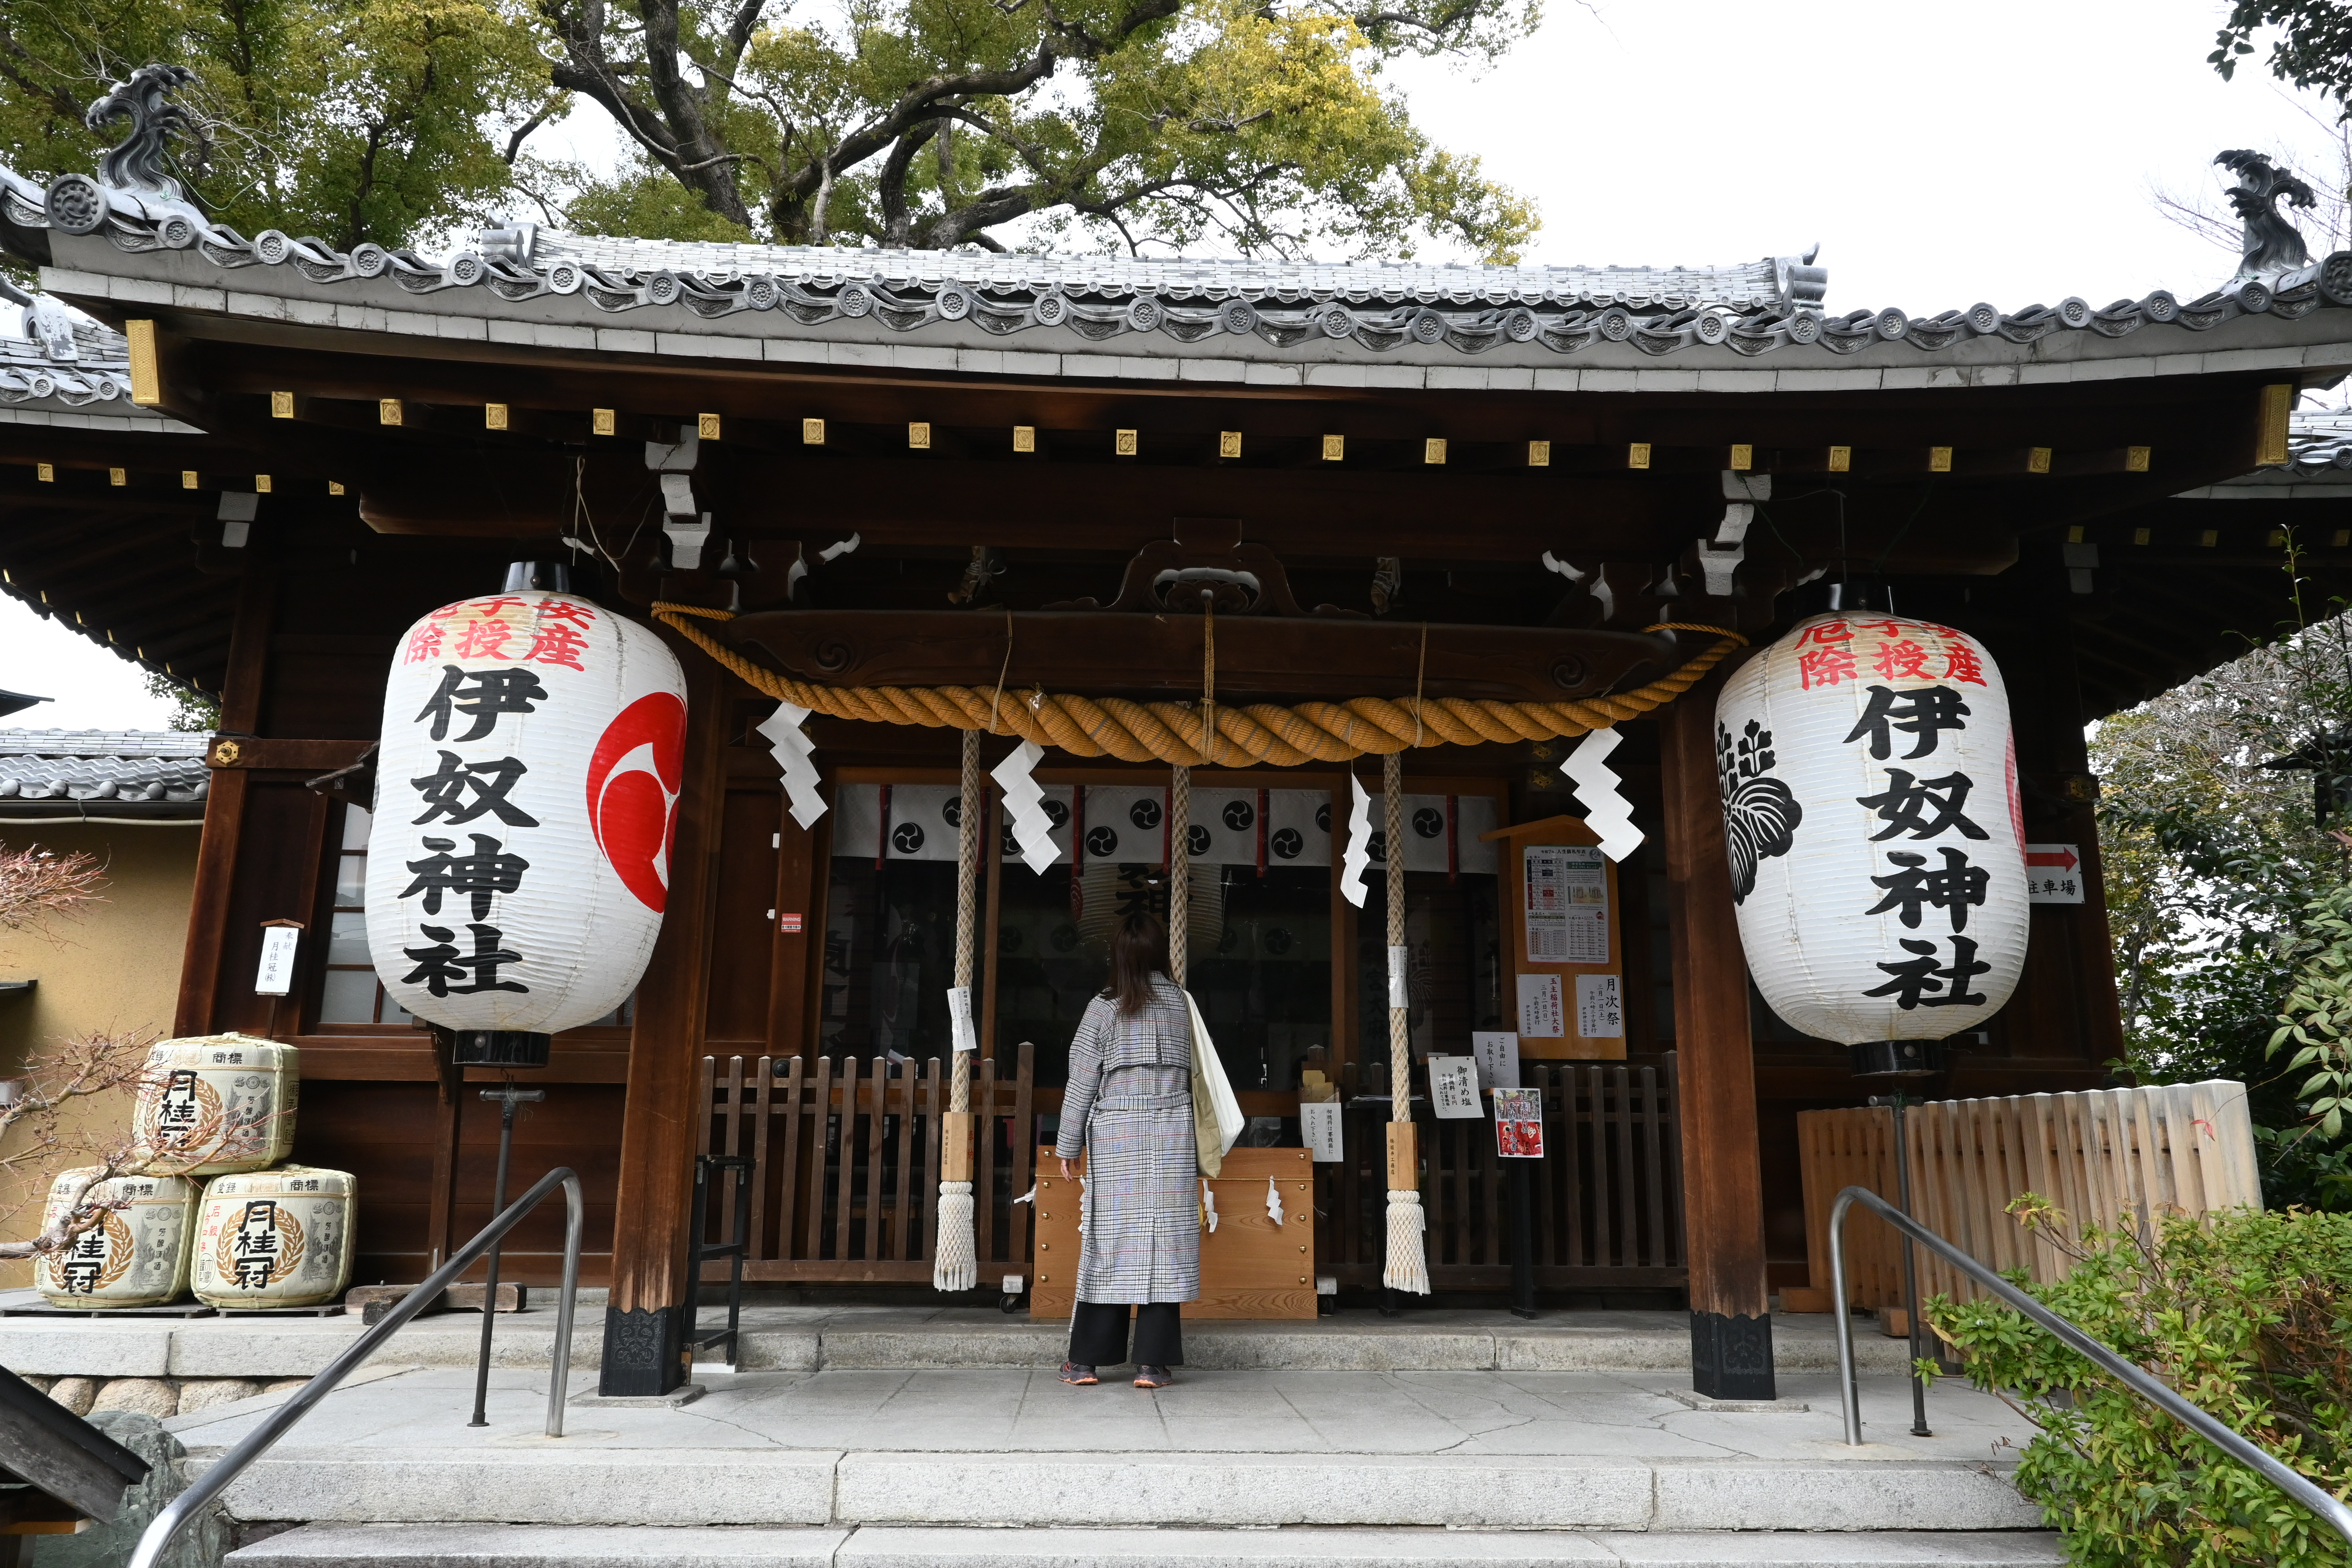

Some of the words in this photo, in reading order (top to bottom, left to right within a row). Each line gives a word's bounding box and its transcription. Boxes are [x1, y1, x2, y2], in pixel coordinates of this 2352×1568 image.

[455, 596, 527, 660] 子授
[522, 600, 596, 672] 安産
[1855, 619, 1936, 681] 子授
[1793, 618, 1859, 691] 厄除
[397, 664, 548, 998] 伊奴神社
[1843, 685, 1992, 1010] 伊奴神社
[283, 932, 294, 950] 奉献
[1550, 978, 1560, 1033] 玉主稲荷社大祭
[1606, 978, 1620, 1025] 月次祭
[212, 1052, 243, 1064] 商標
[1486, 1041, 1494, 1084] お取り下さい
[1451, 1094, 1458, 1105] 百円
[1457, 1066, 1473, 1106] 御清め塩
[1520, 1092, 1528, 1133] 玉主稲荷社
[122, 1184, 153, 1196] 商標
[217, 1182, 236, 1194] 登録
[290, 1180, 319, 1191] 商標
[232, 1200, 278, 1290] 月桂冠
